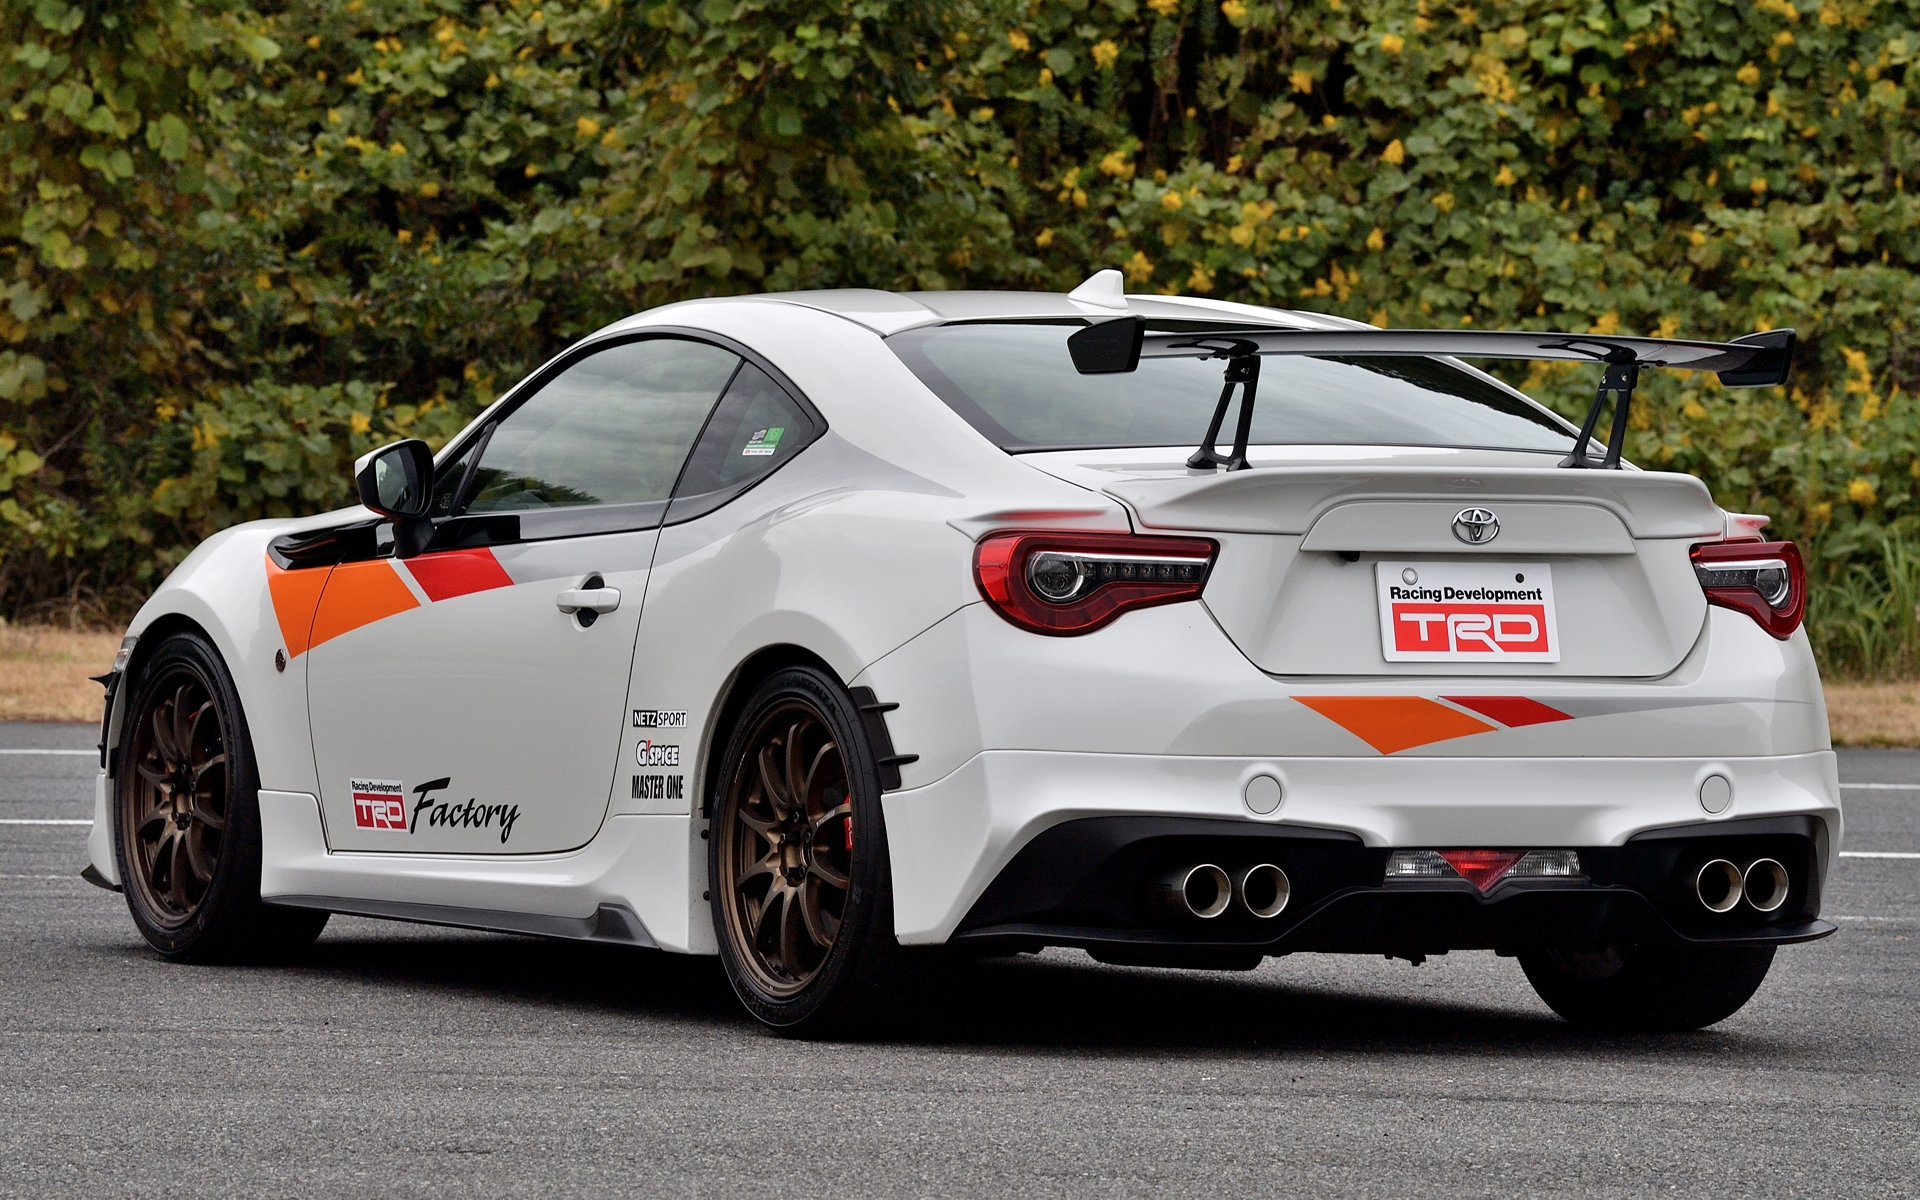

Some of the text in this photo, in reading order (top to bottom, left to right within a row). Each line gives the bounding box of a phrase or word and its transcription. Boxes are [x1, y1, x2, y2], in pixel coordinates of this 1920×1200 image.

[1390, 586, 1542, 602] Racing Development
[1400, 613, 1539, 653] TRD
[634, 711, 686, 726] NETZ SPORT
[351, 781, 402, 793] Racing Development
[631, 775, 683, 799] MASTER ONE
[356, 799, 403, 829] TRD
[410, 776, 521, 844] Factory
